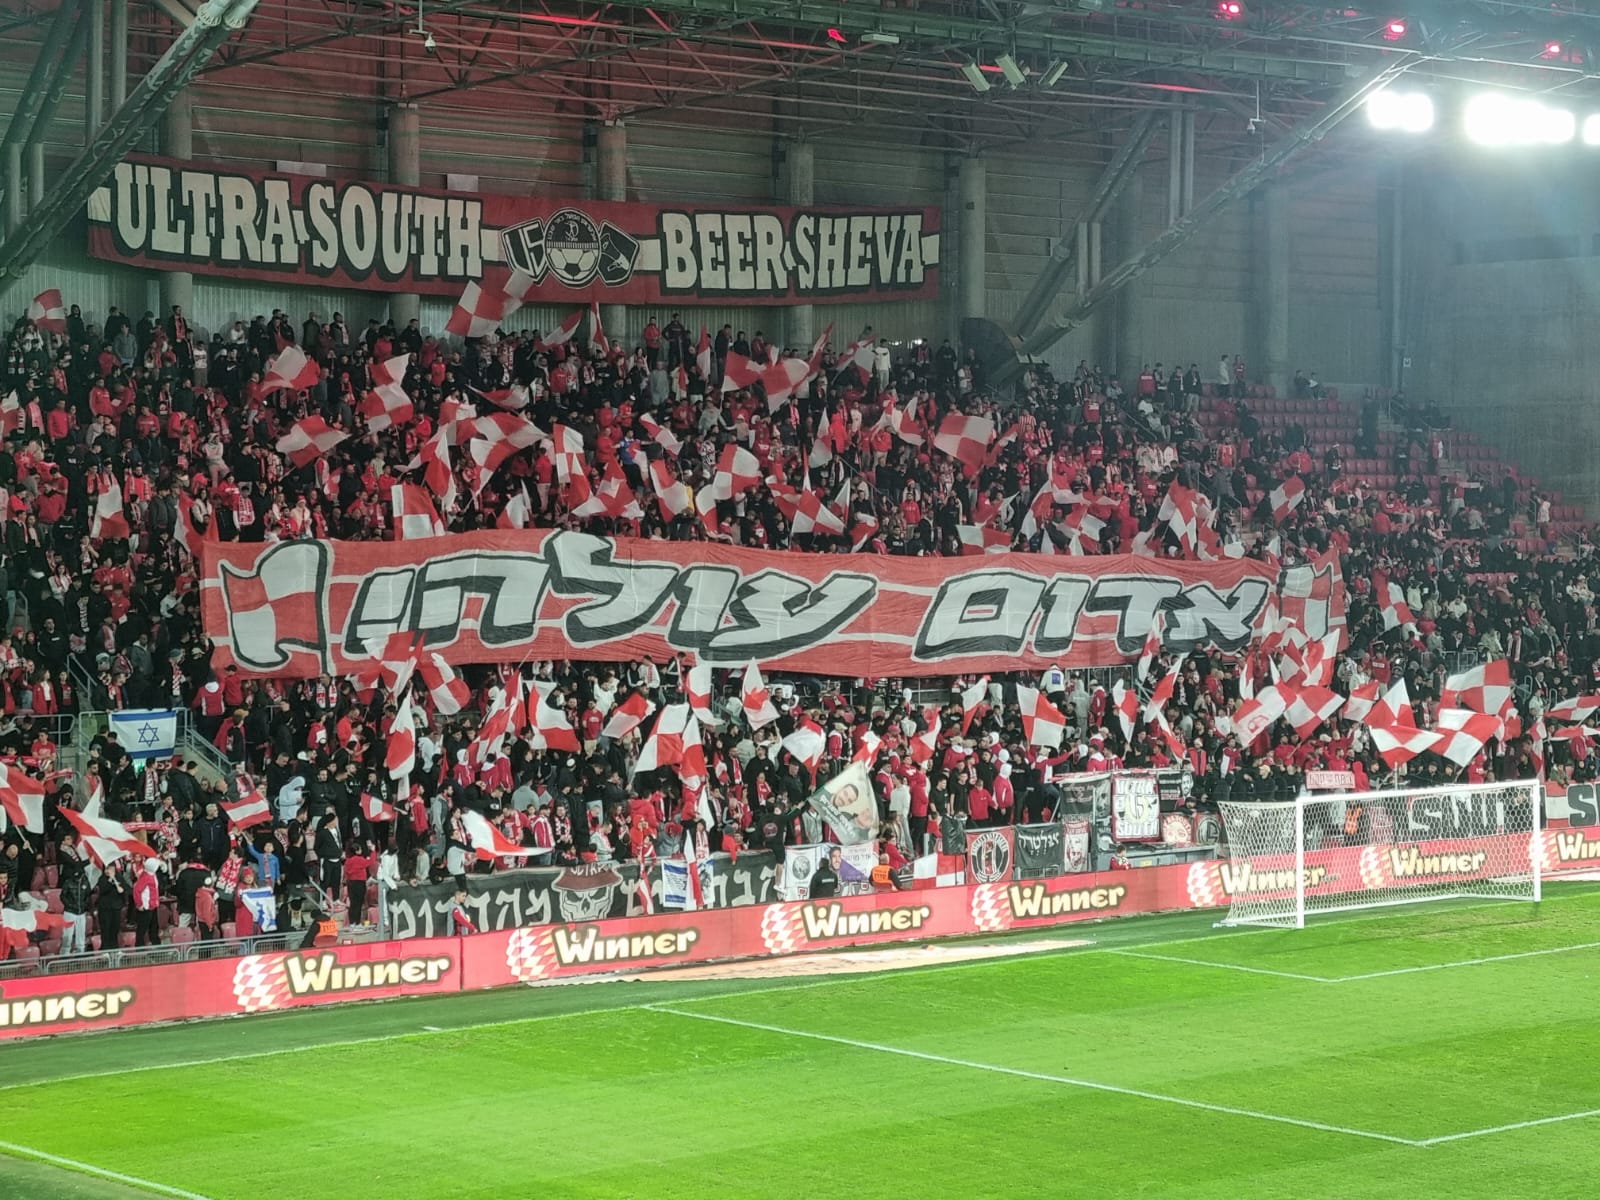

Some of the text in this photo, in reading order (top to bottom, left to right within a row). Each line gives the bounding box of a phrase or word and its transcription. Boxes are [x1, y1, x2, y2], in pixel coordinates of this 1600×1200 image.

[115, 162, 483, 278] ULTRA SOUTH
[662, 213, 925, 290] BEER SHEVA
[918, 571, 1268, 658] אדום
[1556, 832, 1600, 861] Win
[1010, 885, 1125, 917] Winner
[803, 904, 930, 938] Winner
[556, 928, 696, 964] Winner
[288, 954, 449, 993] Winner
[0, 990, 131, 1024] inner
